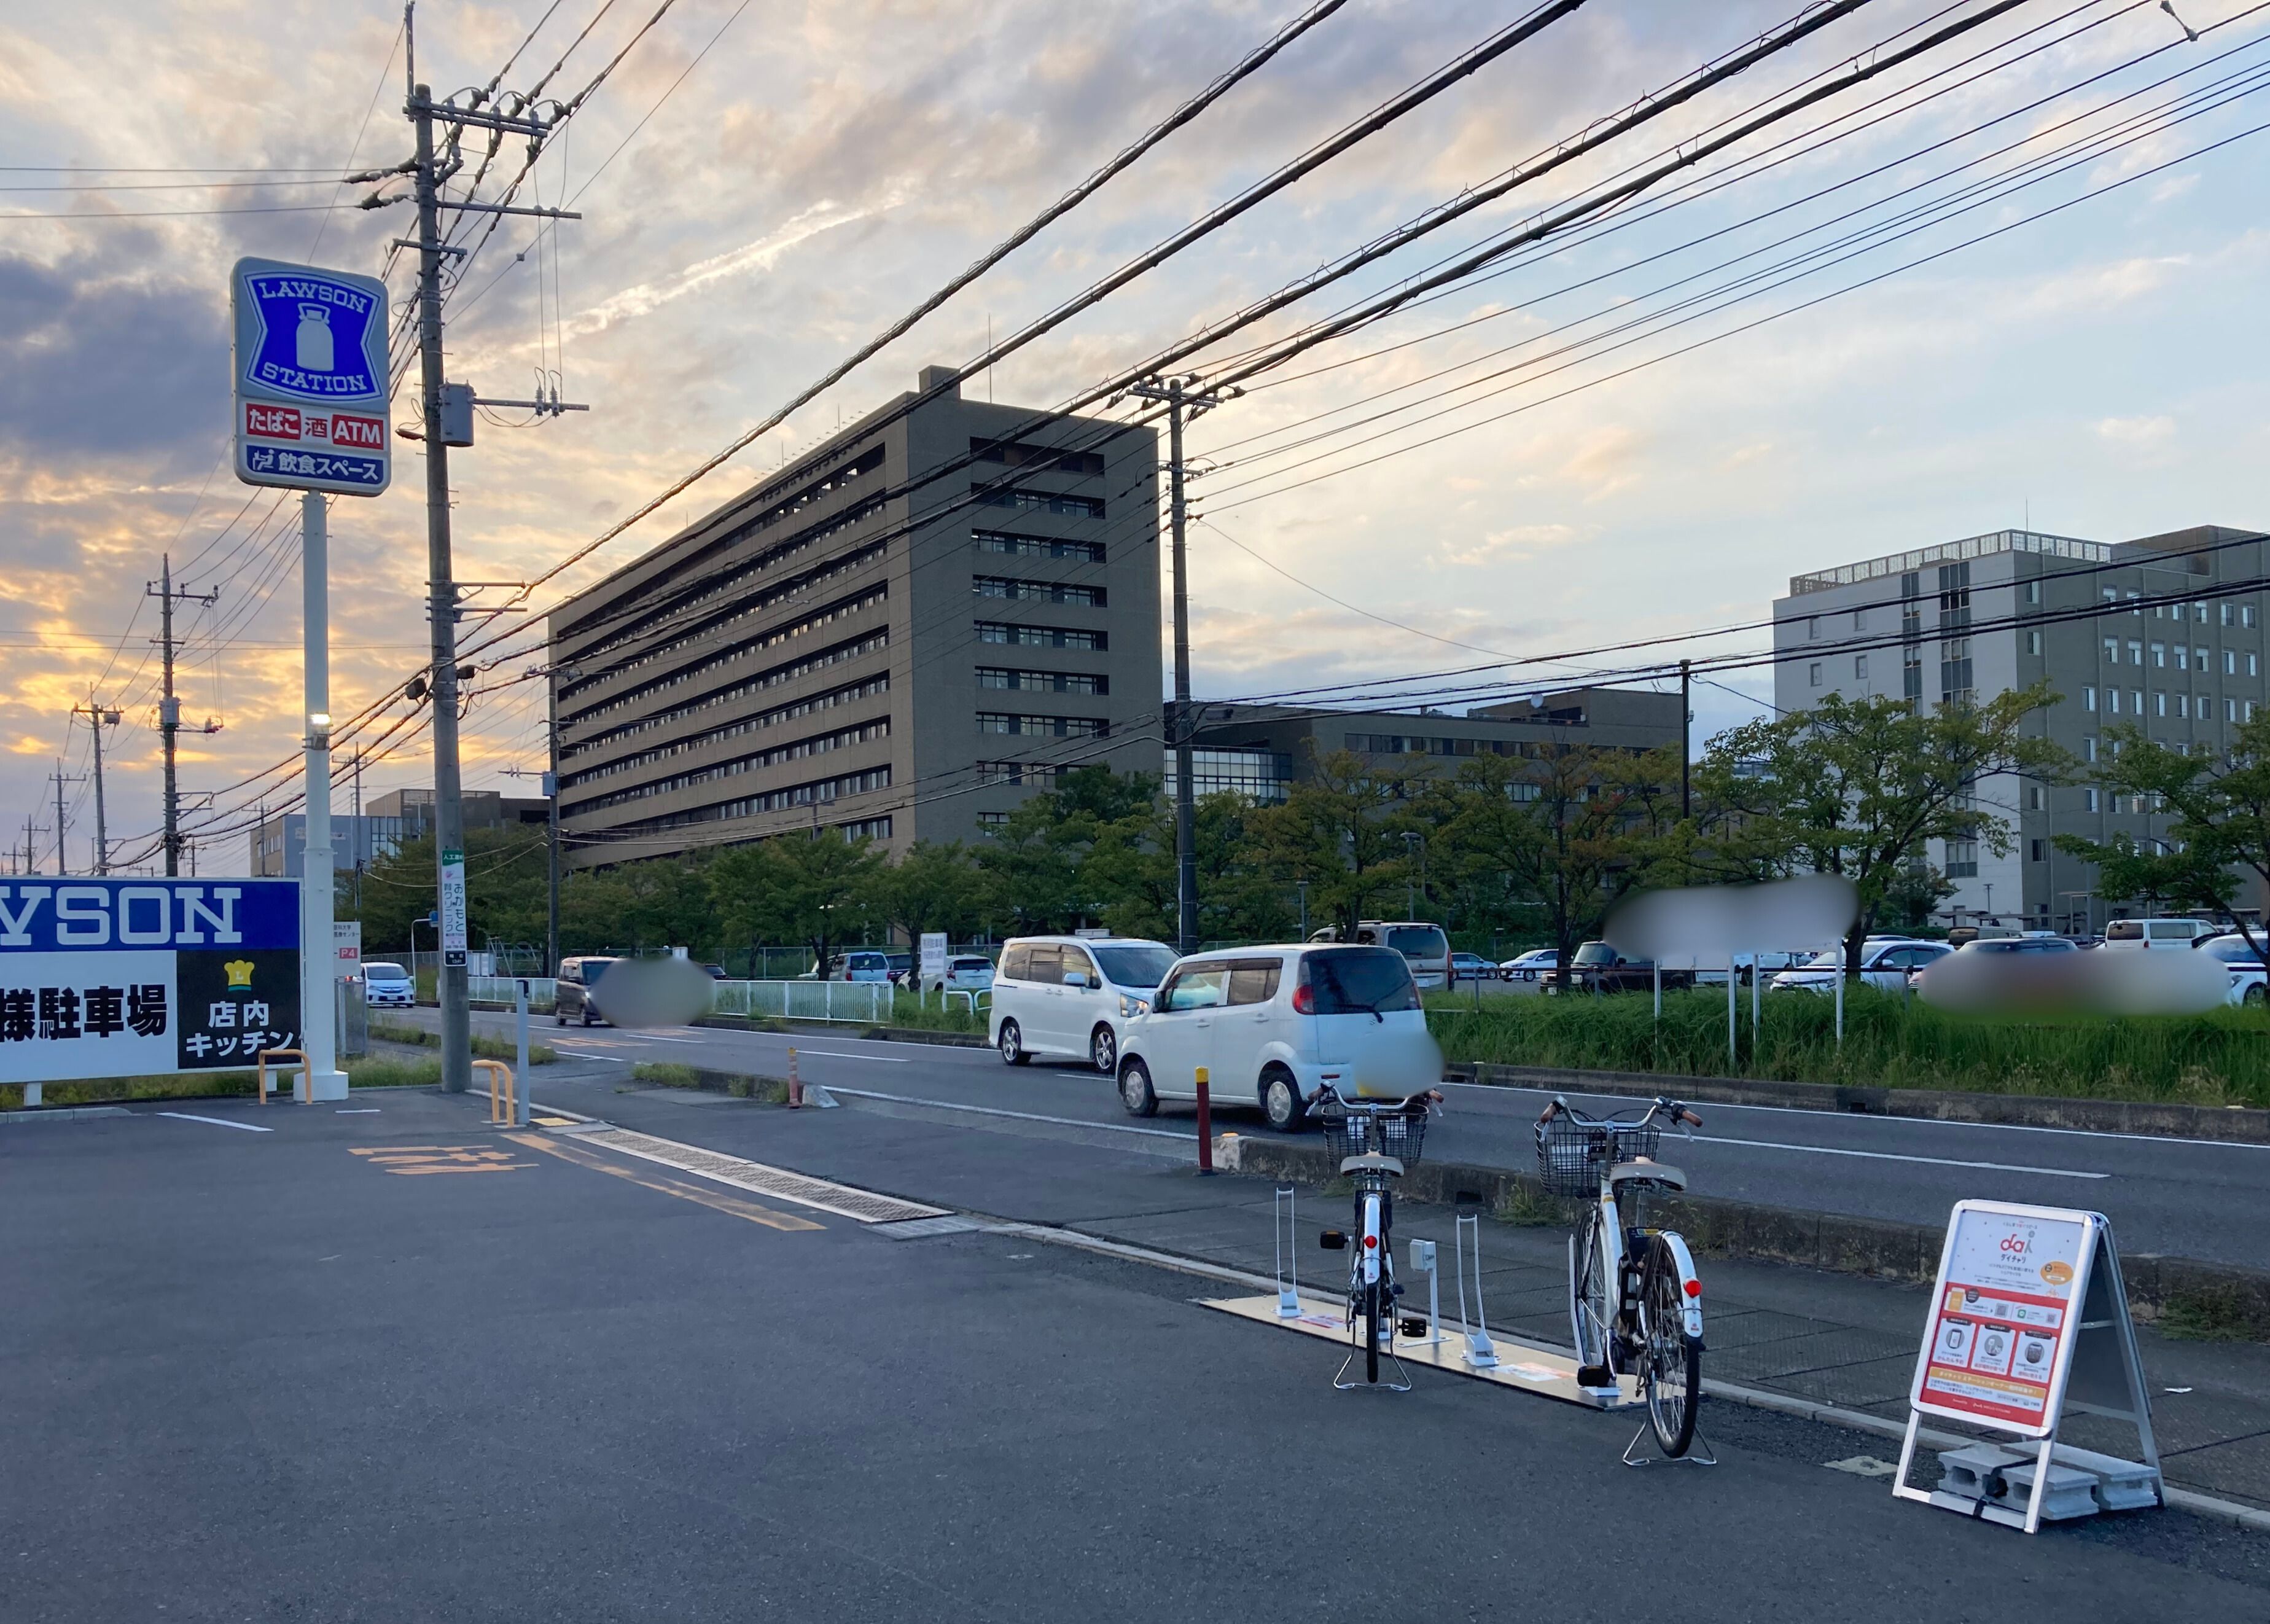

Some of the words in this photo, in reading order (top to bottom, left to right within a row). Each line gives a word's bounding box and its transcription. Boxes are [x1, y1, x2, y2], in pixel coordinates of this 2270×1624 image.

[259, 281, 367, 314] LAWSON
[262, 362, 367, 392] STATION
[249, 408, 300, 434] たばこ
[305, 417, 328, 438] 酒
[334, 420, 381, 444] ATM
[278, 451, 379, 480] 飲食スペース
[341, 948, 355, 958] P4
[0, 984, 167, 1043] 様駐車場
[208, 1000, 269, 1029] 店内
[186, 1031, 294, 1058] キッチン
[2000, 1254, 2027, 1264] ダイチャリ
